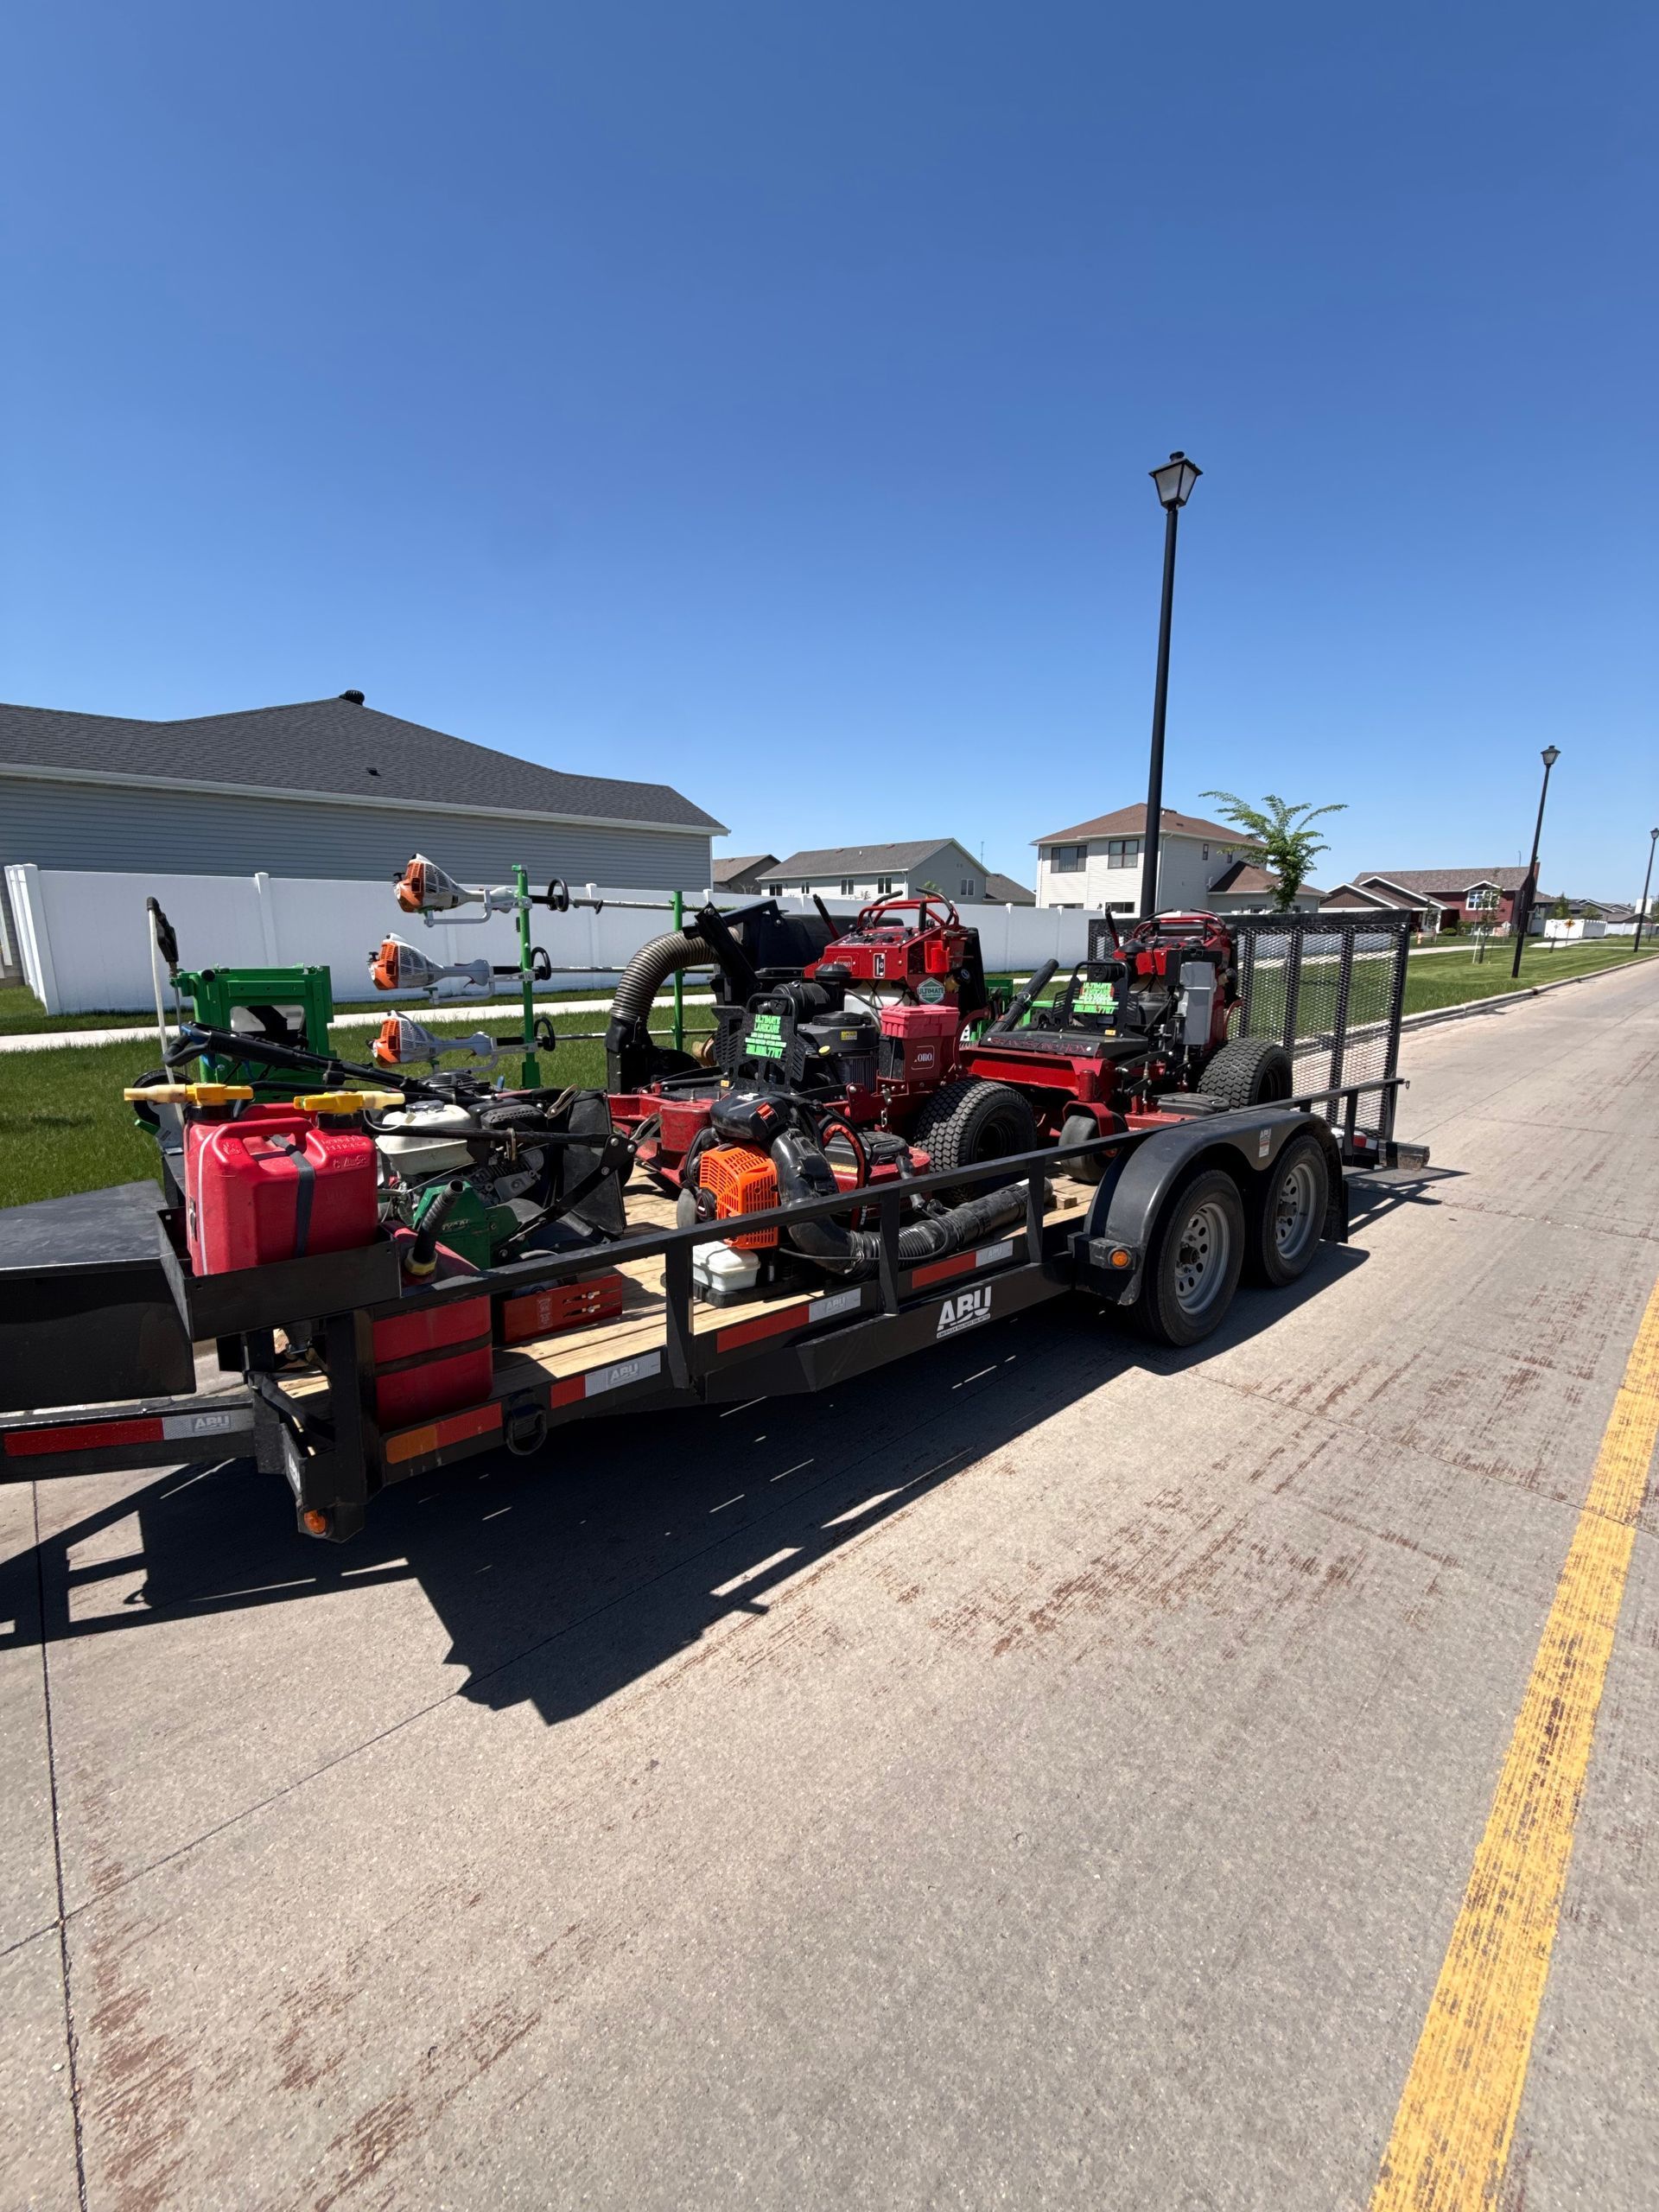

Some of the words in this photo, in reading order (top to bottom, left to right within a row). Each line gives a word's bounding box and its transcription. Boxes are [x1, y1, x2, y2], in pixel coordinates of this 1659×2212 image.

[754, 1014, 781, 1024] ULTIMATE
[937, 1286, 992, 1332] ABU
[610, 1363, 639, 1382] ABU
[194, 1414, 230, 1430] ABU
